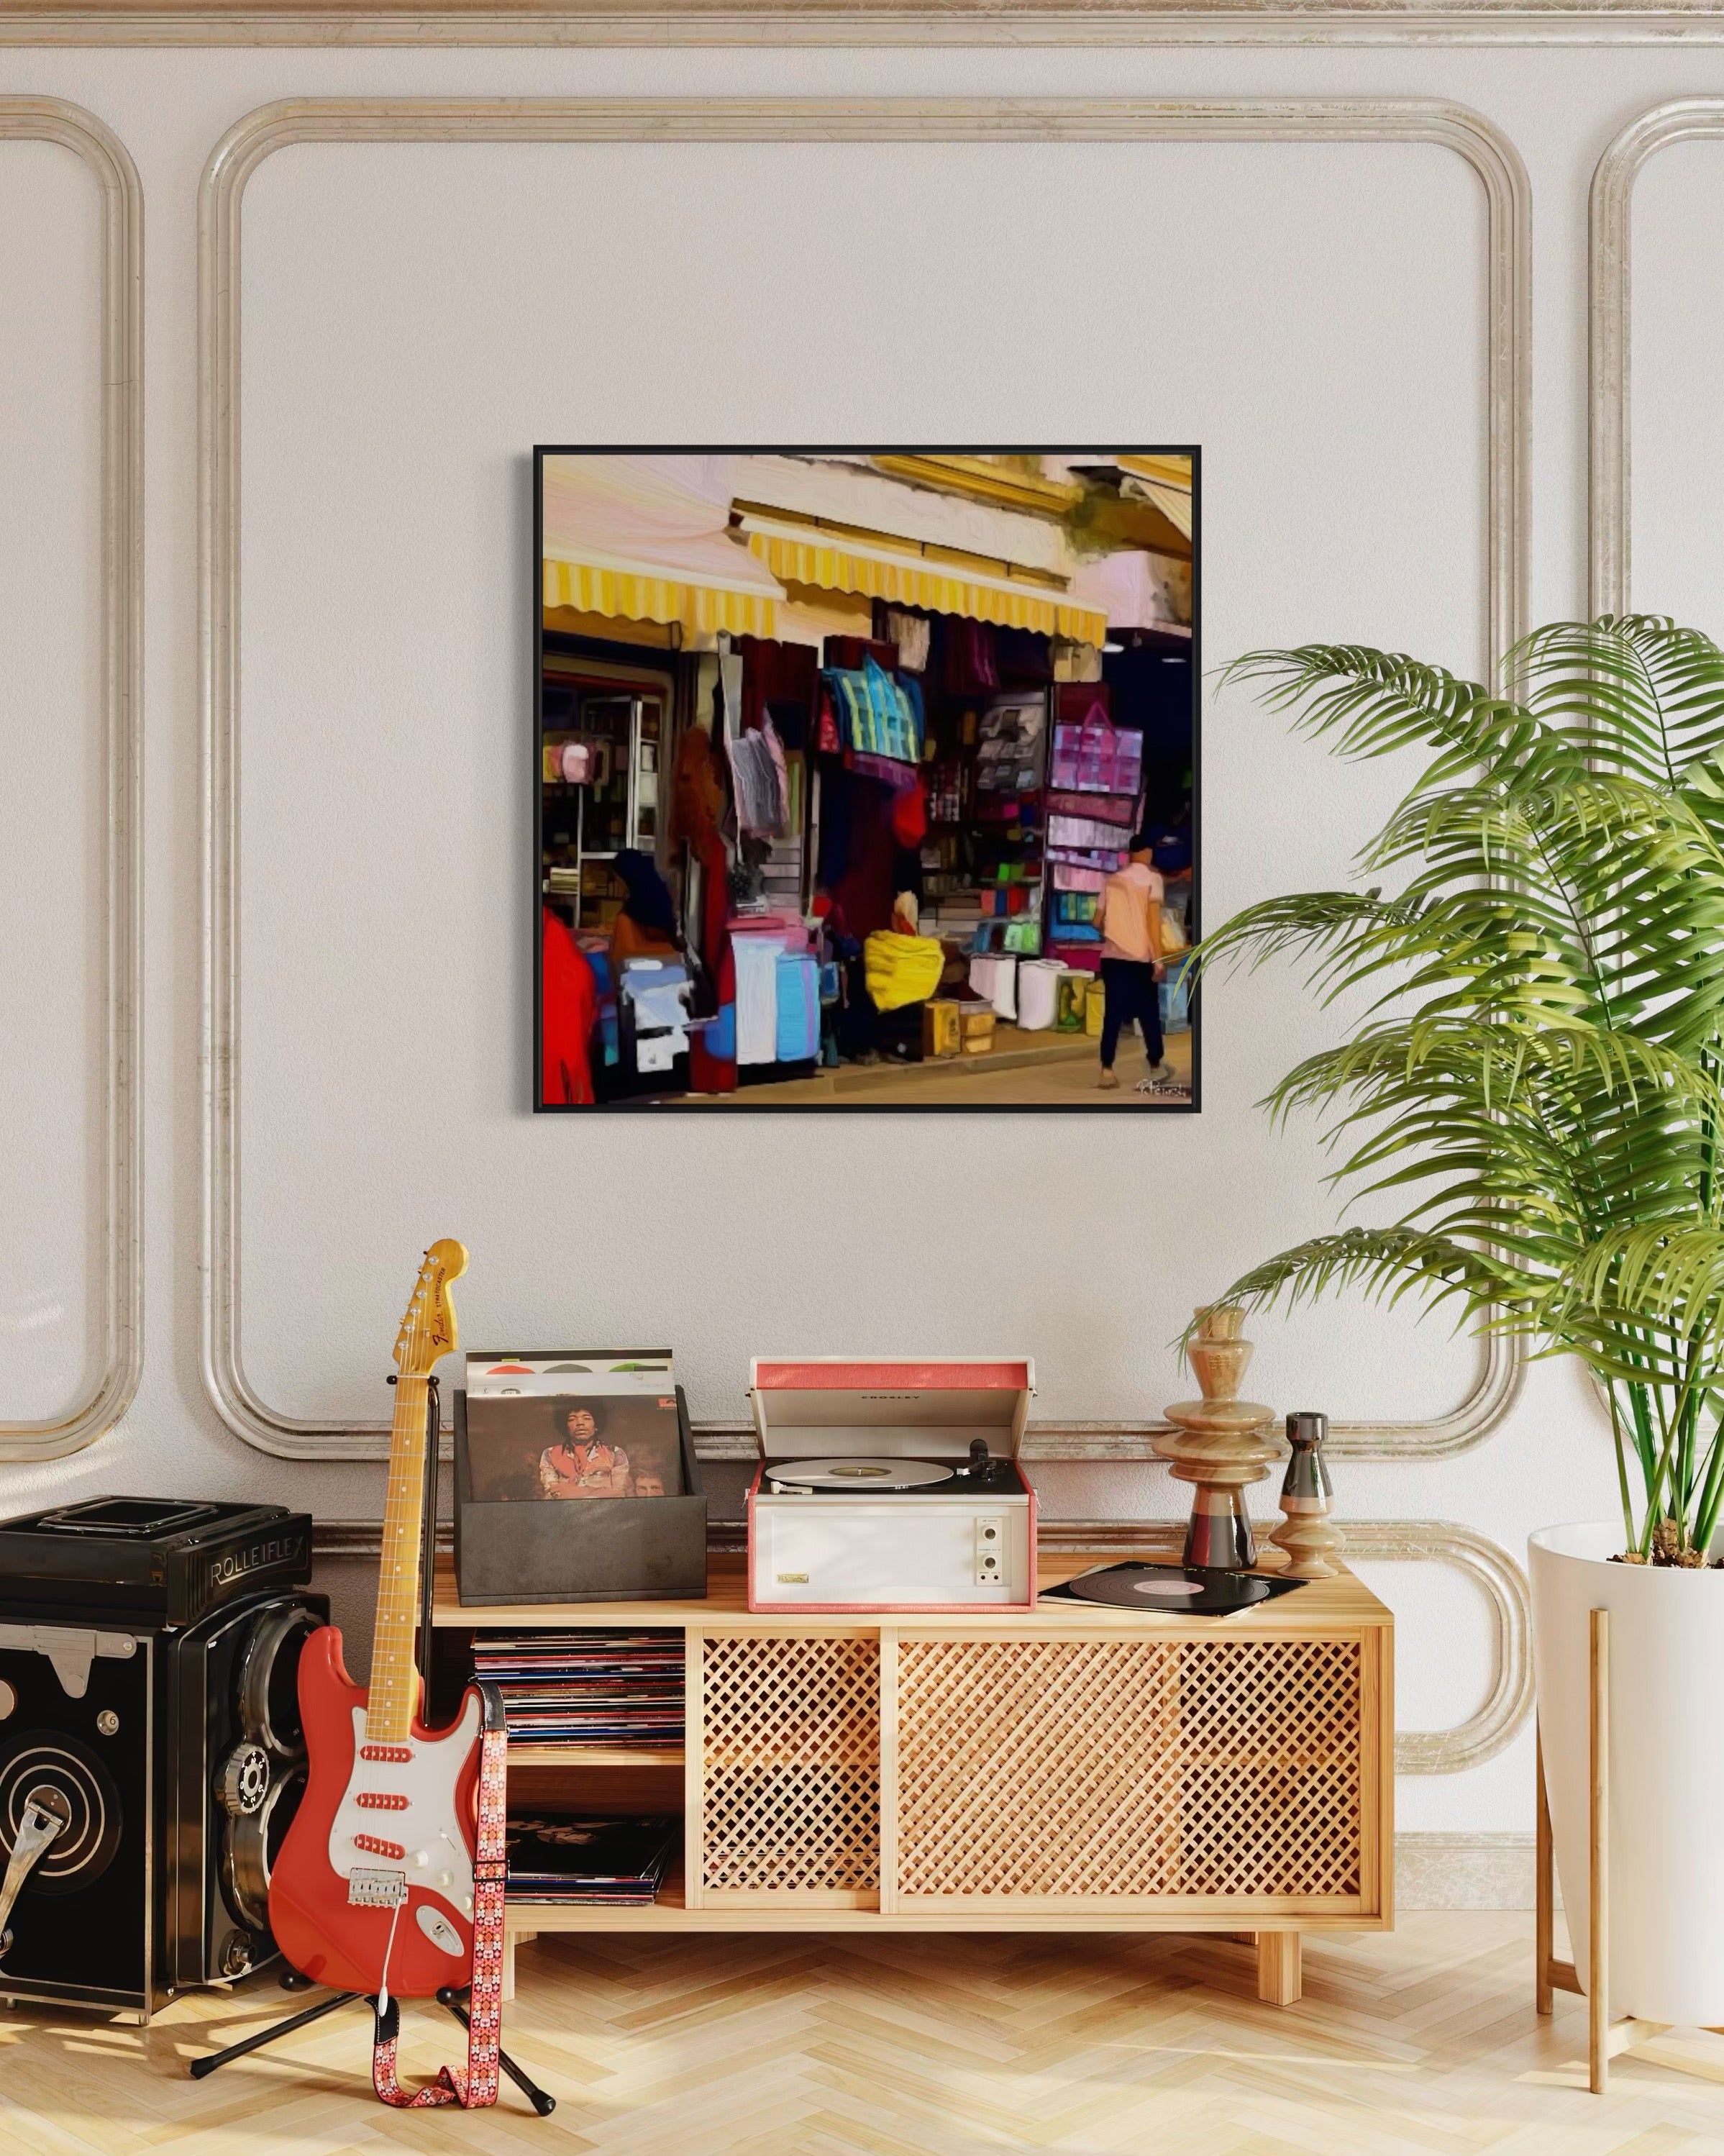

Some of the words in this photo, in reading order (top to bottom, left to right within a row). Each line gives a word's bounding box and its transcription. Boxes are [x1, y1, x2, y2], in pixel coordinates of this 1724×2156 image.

[435, 1267, 446, 1308] STRATOCASTER
[432, 1312, 449, 1346] Fender
[211, 1536, 304, 1588] ROLLEIFLEX
[109, 1716, 116, 1725] 6
